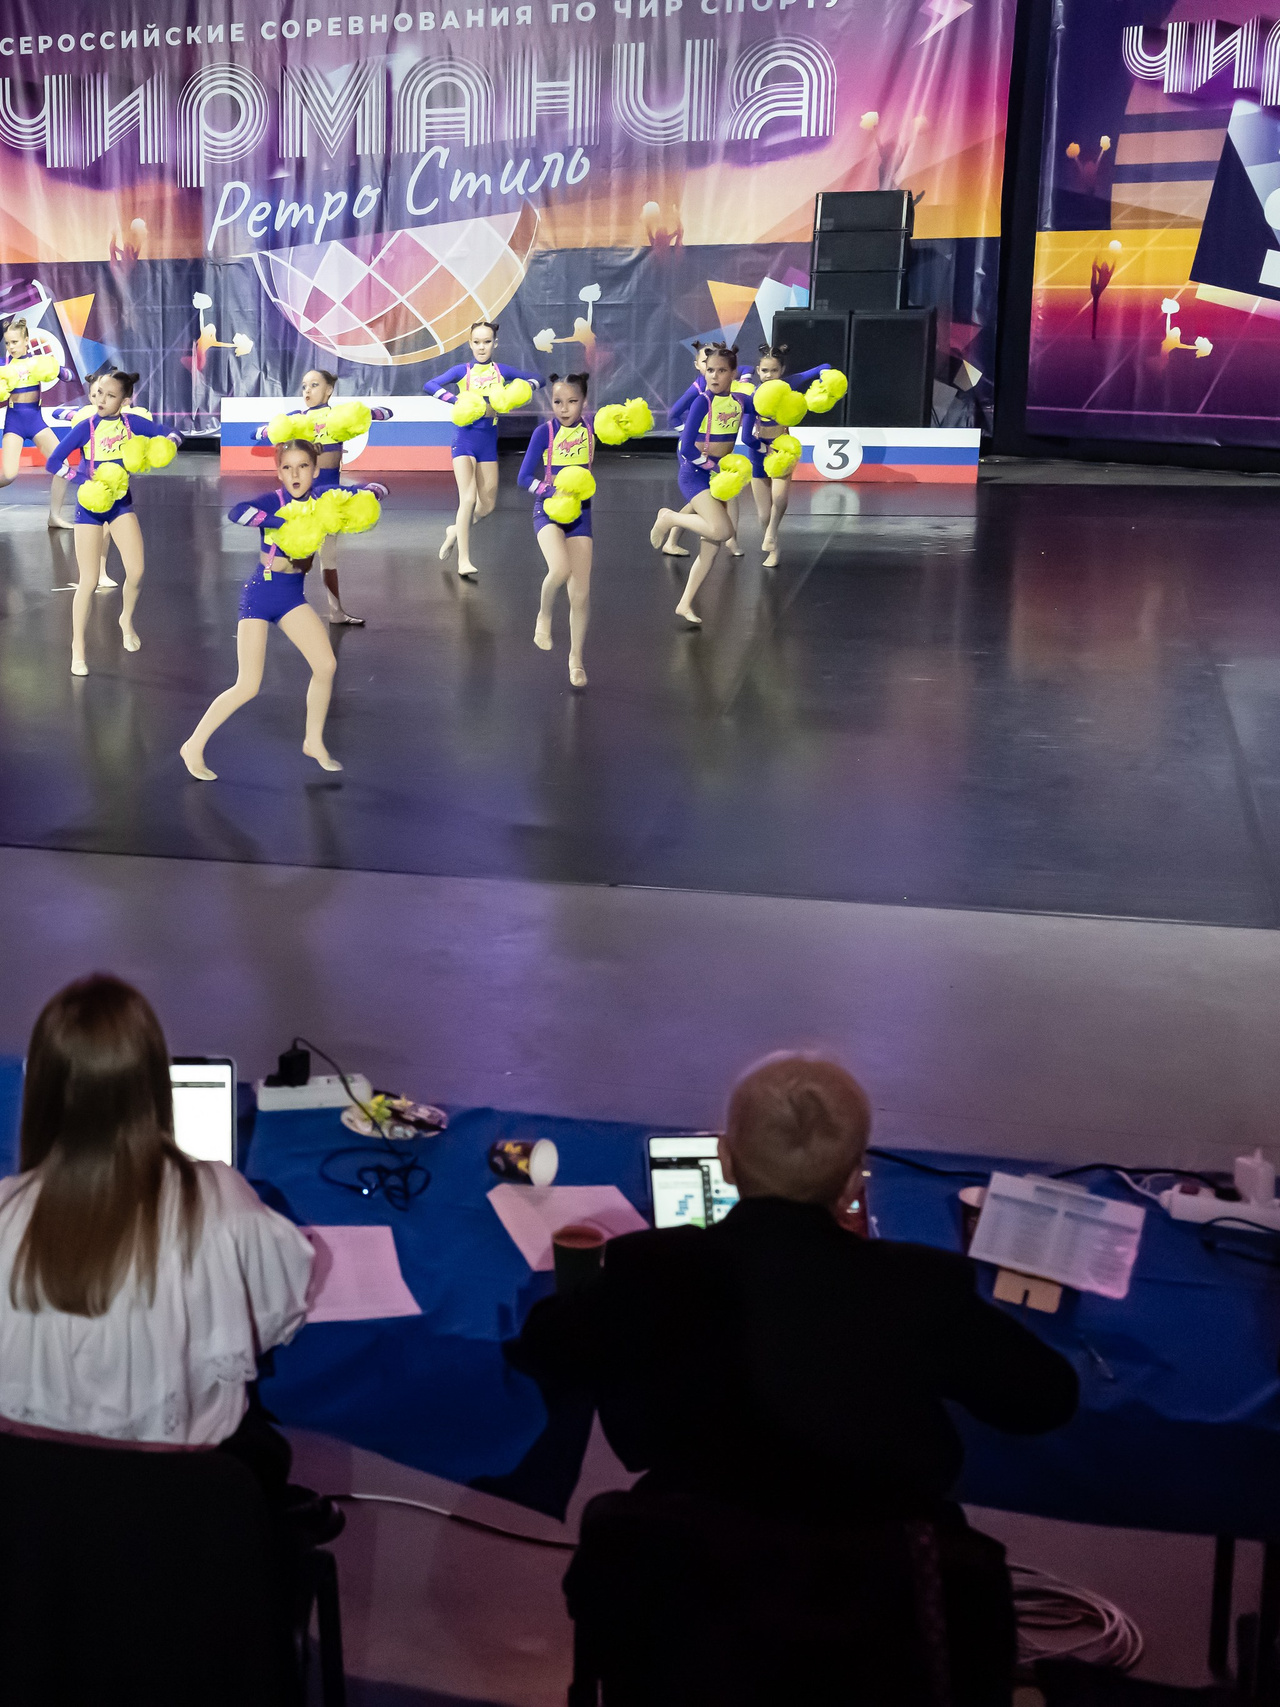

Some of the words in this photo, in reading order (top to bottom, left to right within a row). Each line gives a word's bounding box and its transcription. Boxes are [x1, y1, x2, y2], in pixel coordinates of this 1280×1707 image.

[261, 5, 533, 41] СОРЕВНОВАНИЯ
[551, 3, 596, 23] ПО
[618, 0, 684, 19] ЧИР
[207, 181, 381, 252] Ретро
[406, 146, 591, 216] Стиль
[825, 438, 851, 471] 3
